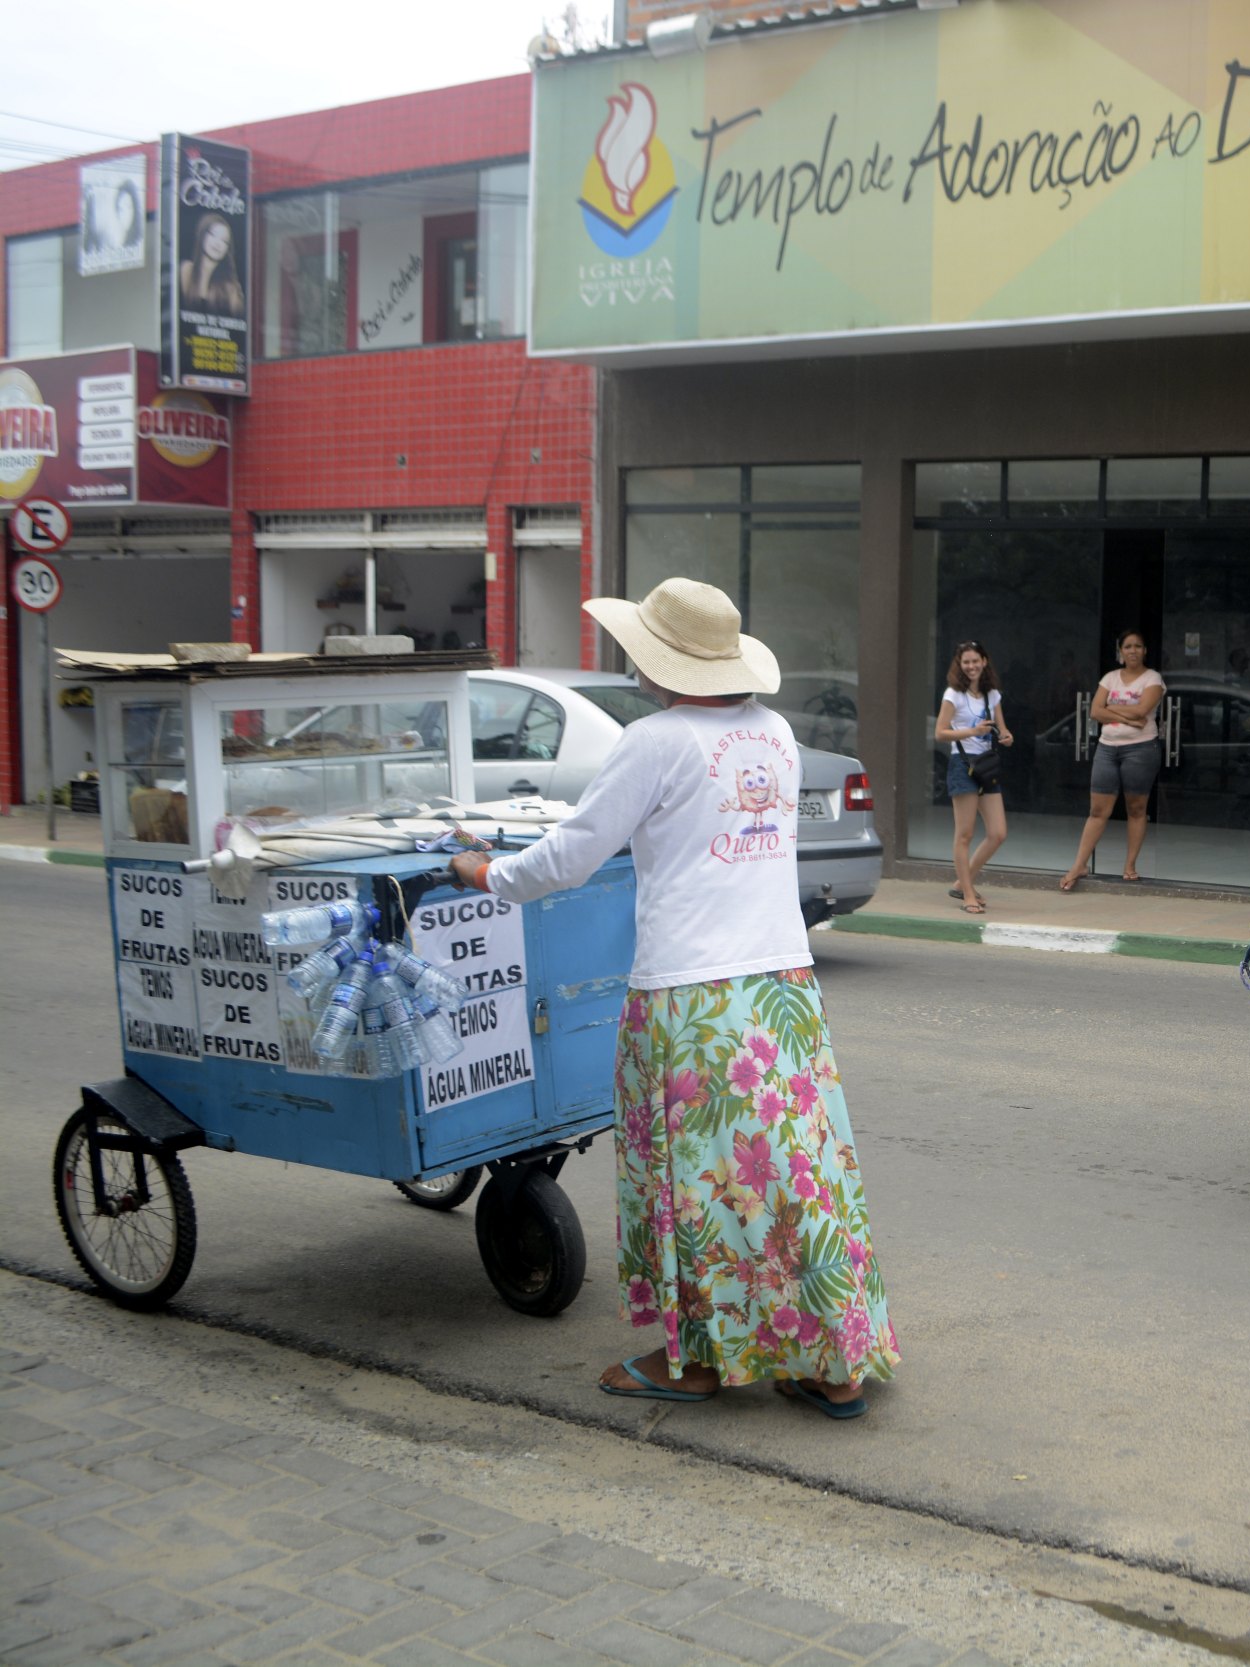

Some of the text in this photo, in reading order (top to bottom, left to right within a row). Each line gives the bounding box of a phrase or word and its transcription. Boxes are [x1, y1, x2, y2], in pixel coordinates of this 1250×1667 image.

[691, 107, 853, 271] Templo
[859, 140, 894, 194] de
[903, 99, 1140, 211] Adoração
[1152, 111, 1201, 160] AO
[579, 256, 673, 280] IGREJA
[580, 286, 674, 306] VIVA
[139, 409, 229, 443] OLIVEIRA
[21, 570, 54, 595] 30
[709, 730, 794, 778] PASTELARIA
[710, 832, 779, 864] Quero
[120, 873, 183, 898] SUCOS
[276, 881, 349, 901] SUCOS
[141, 908, 164, 929] DE
[420, 897, 512, 931] SUCOS
[121, 938, 191, 966] FRUTAS
[192, 921, 221, 960] ÁGUA
[222, 931, 272, 964] MINERAL
[451, 936, 487, 961] DE
[140, 967, 174, 1000] TEMOS
[201, 967, 268, 992] SUCOS
[465, 964, 523, 992] TAS
[224, 1003, 251, 1025] DE
[449, 999, 498, 1038] TEMOS
[154, 1023, 200, 1058] MINERAL
[203, 1034, 280, 1061] FRUTAS
[428, 1048, 532, 1108] ÁGUA MINERAL
